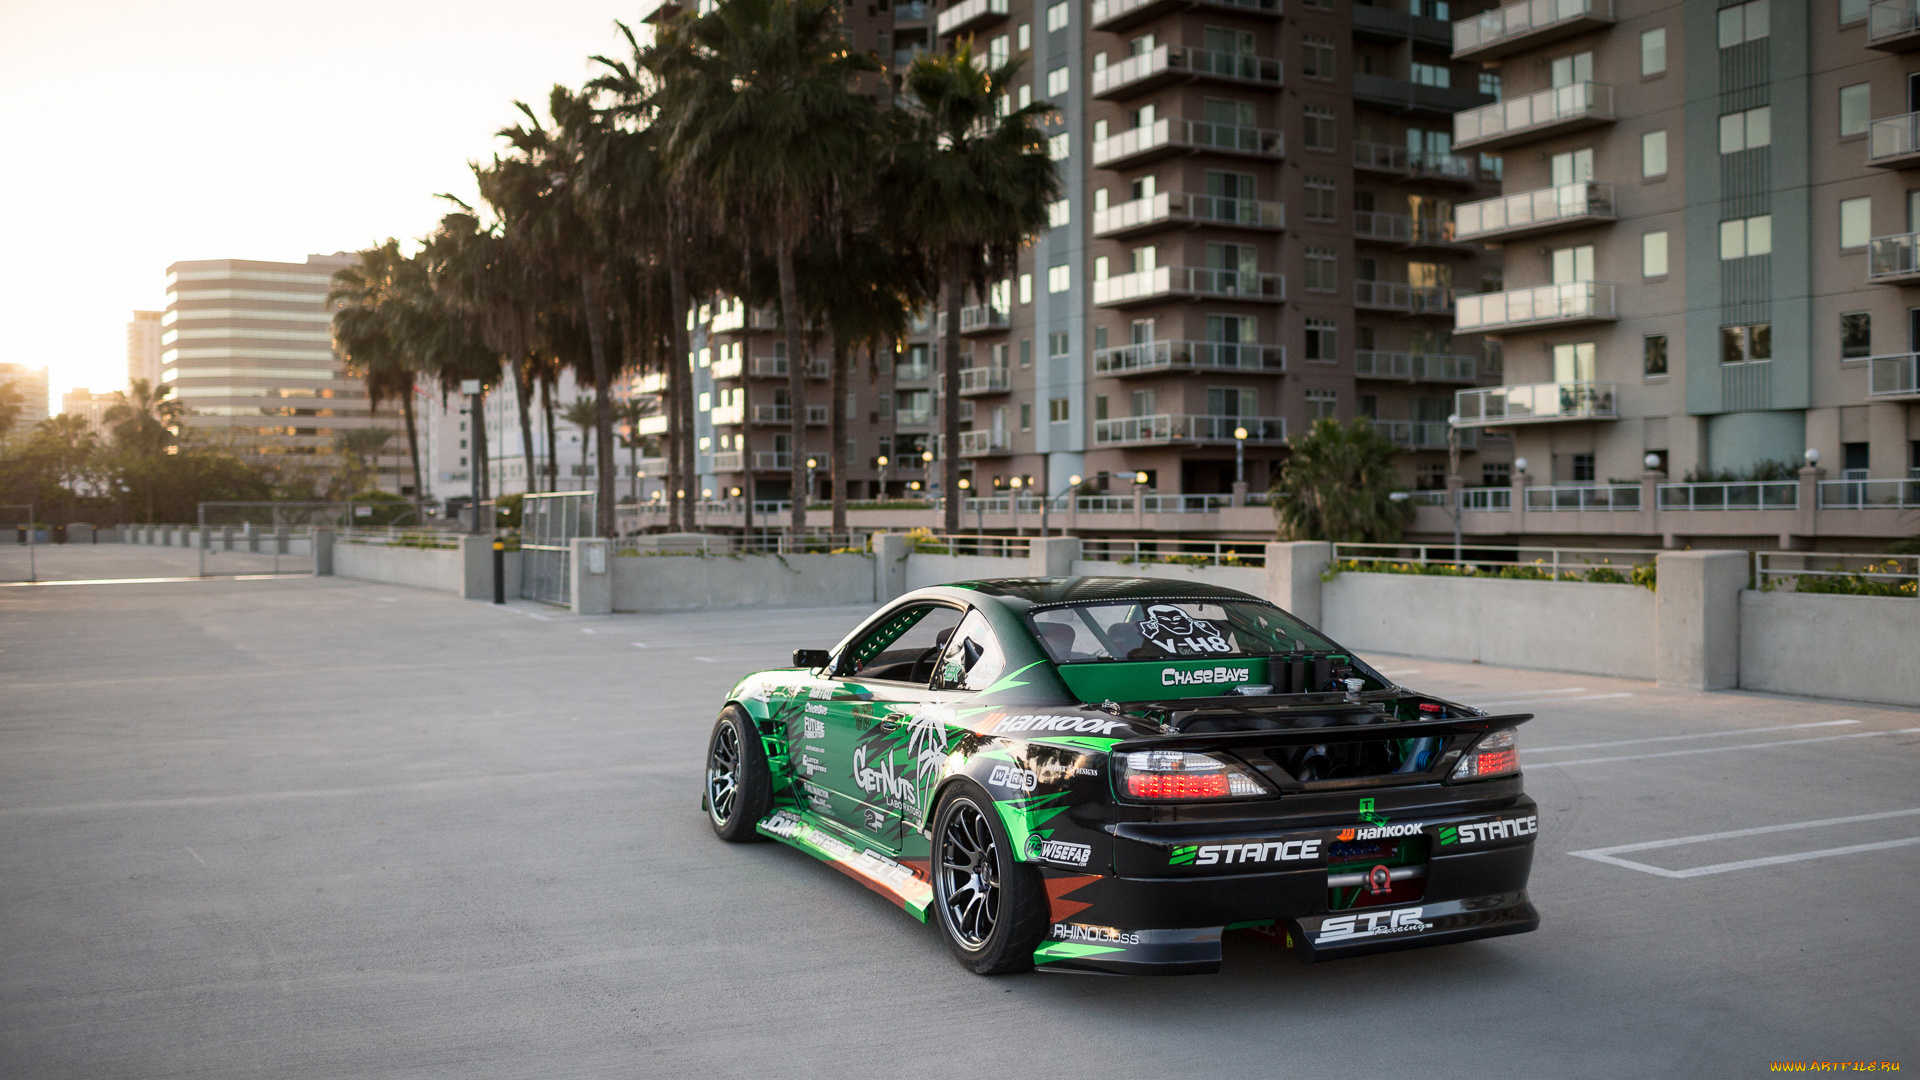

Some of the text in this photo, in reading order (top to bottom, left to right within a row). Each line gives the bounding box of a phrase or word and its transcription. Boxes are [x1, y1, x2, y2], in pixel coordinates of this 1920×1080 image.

[1152, 636, 1231, 654] V-H8
[1458, 815, 1538, 843] STANCE
[1041, 842, 1091, 863] WISEFAB
[1195, 839, 1322, 865] STANCE
[1318, 907, 1423, 938] STR
[1373, 922, 1429, 936] Racing
